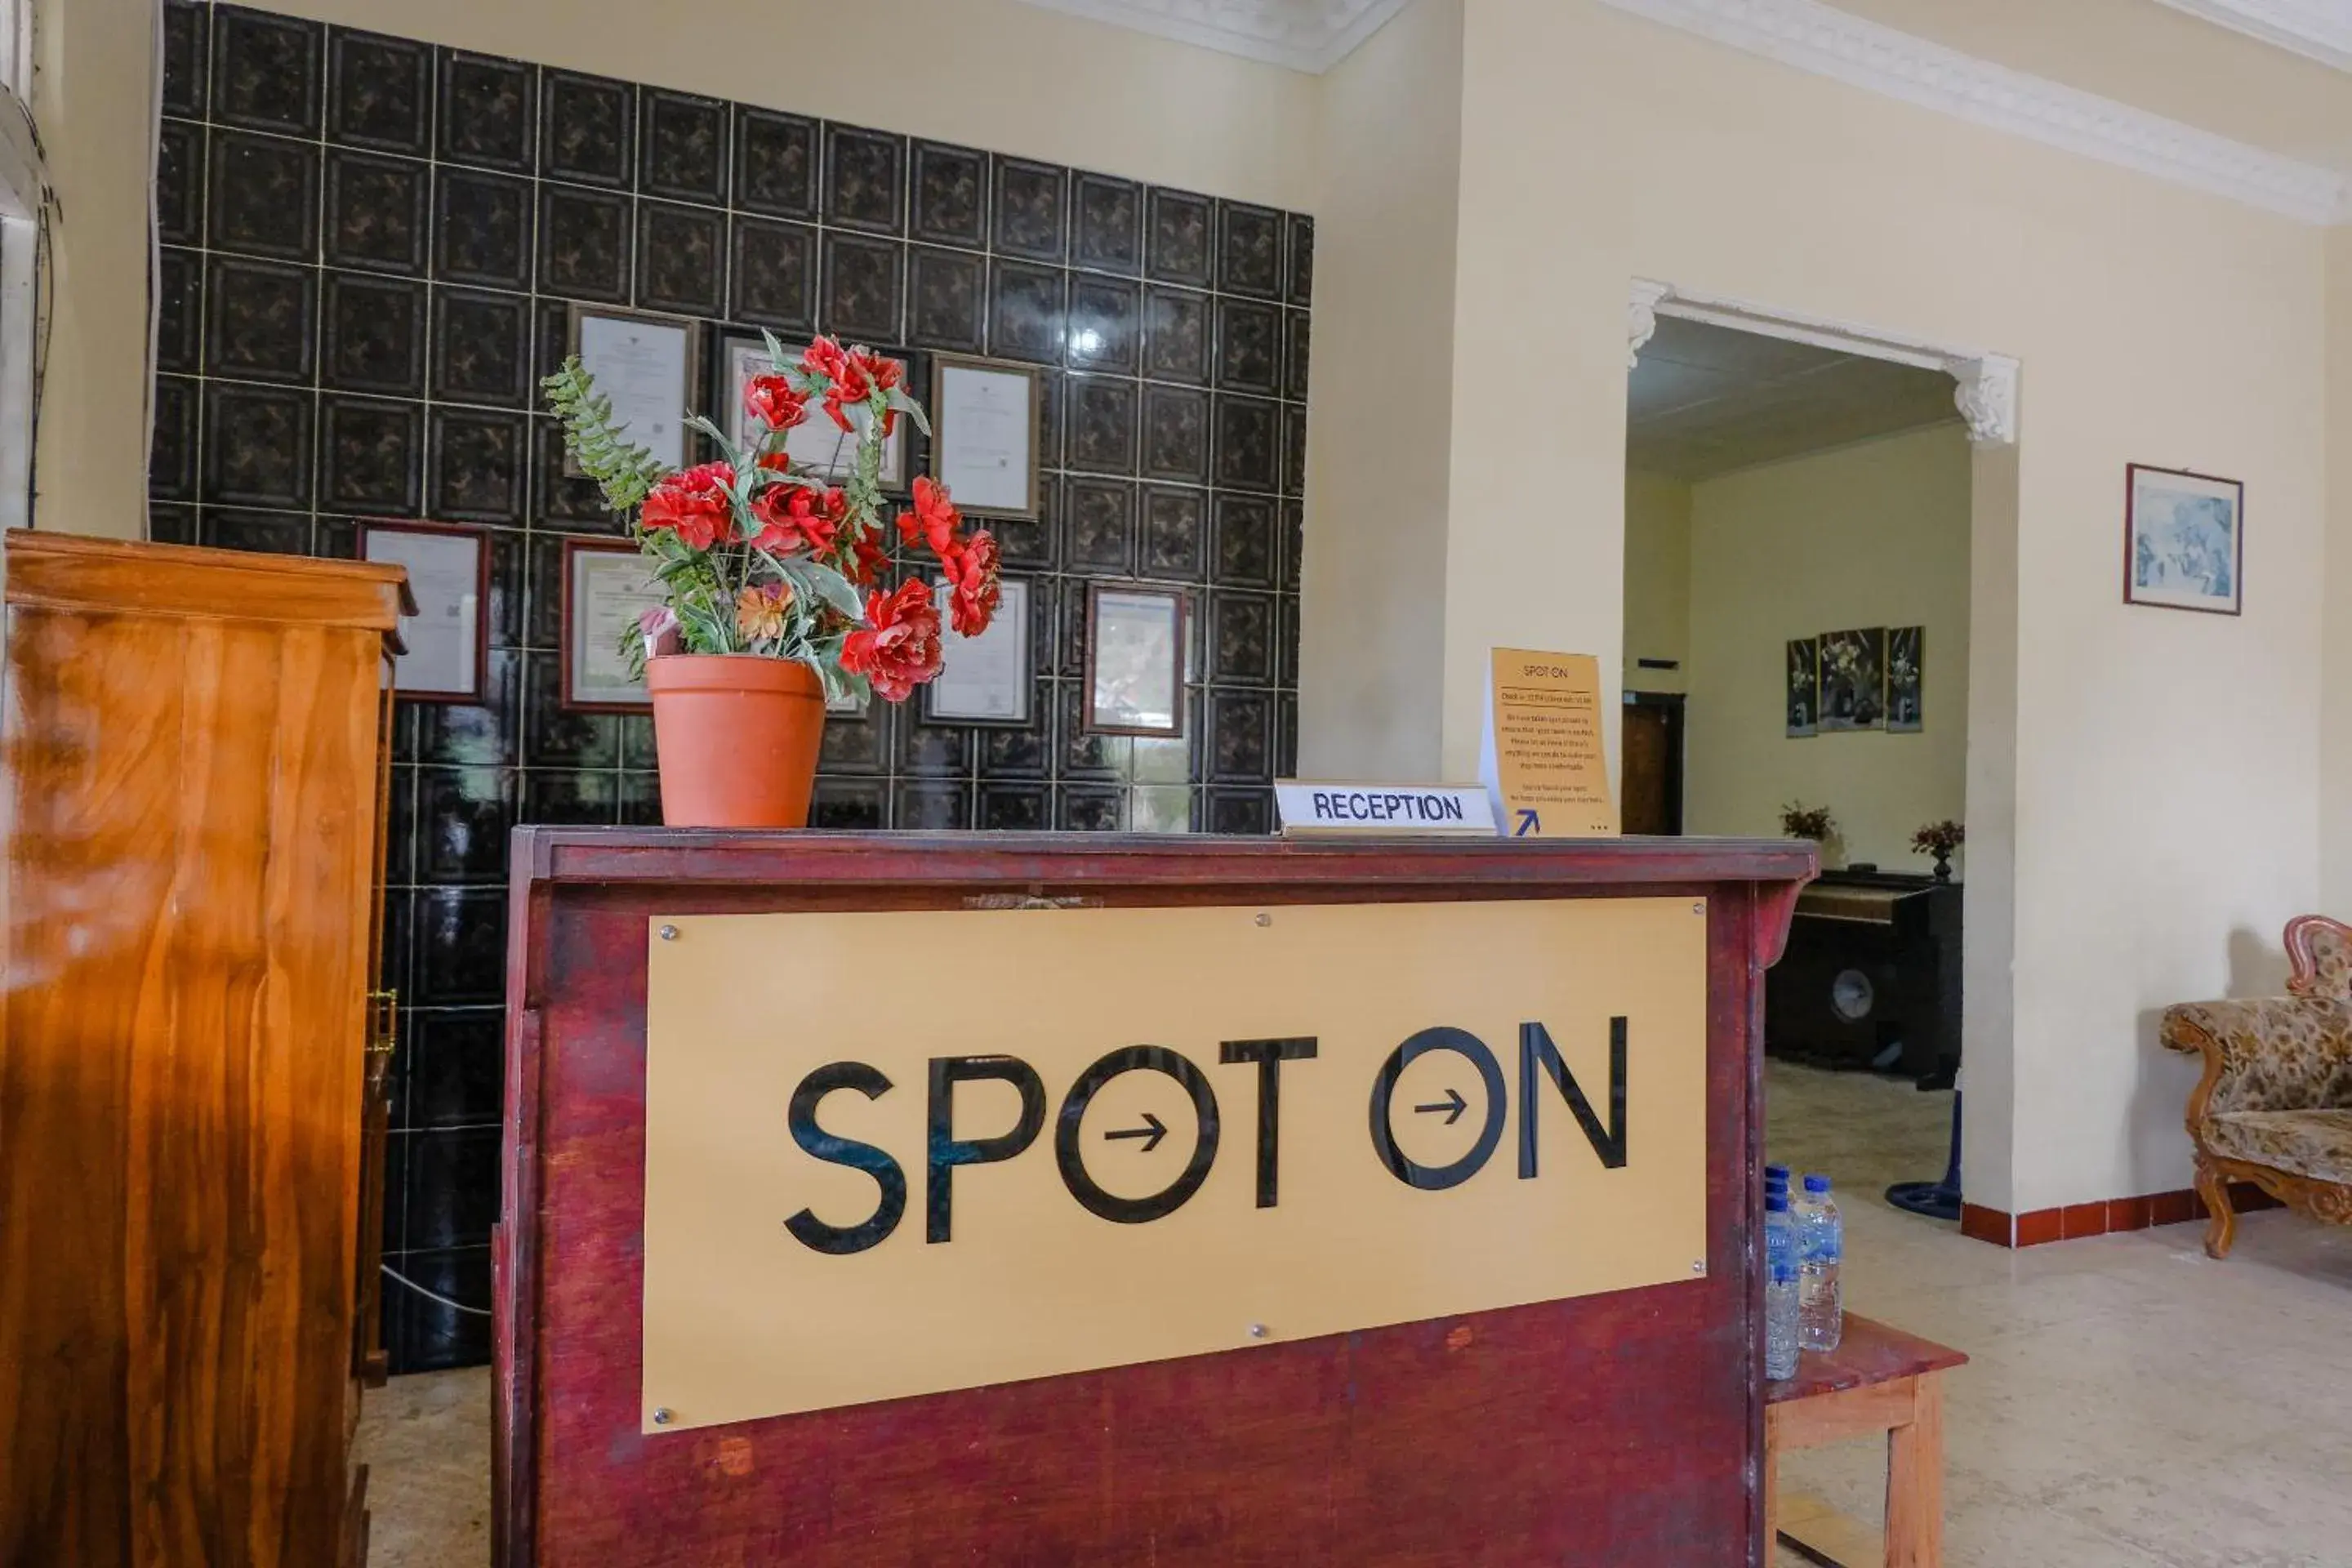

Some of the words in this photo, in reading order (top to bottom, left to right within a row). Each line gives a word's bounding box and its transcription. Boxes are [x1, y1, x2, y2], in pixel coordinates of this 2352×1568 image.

[1524, 666, 1548, 678] SPOT
[1552, 666, 1568, 679] ON
[1312, 792, 1463, 820] RECEPTION
[783, 1036, 1317, 1254] SPOT
[1369, 1015, 1628, 1190] ON
